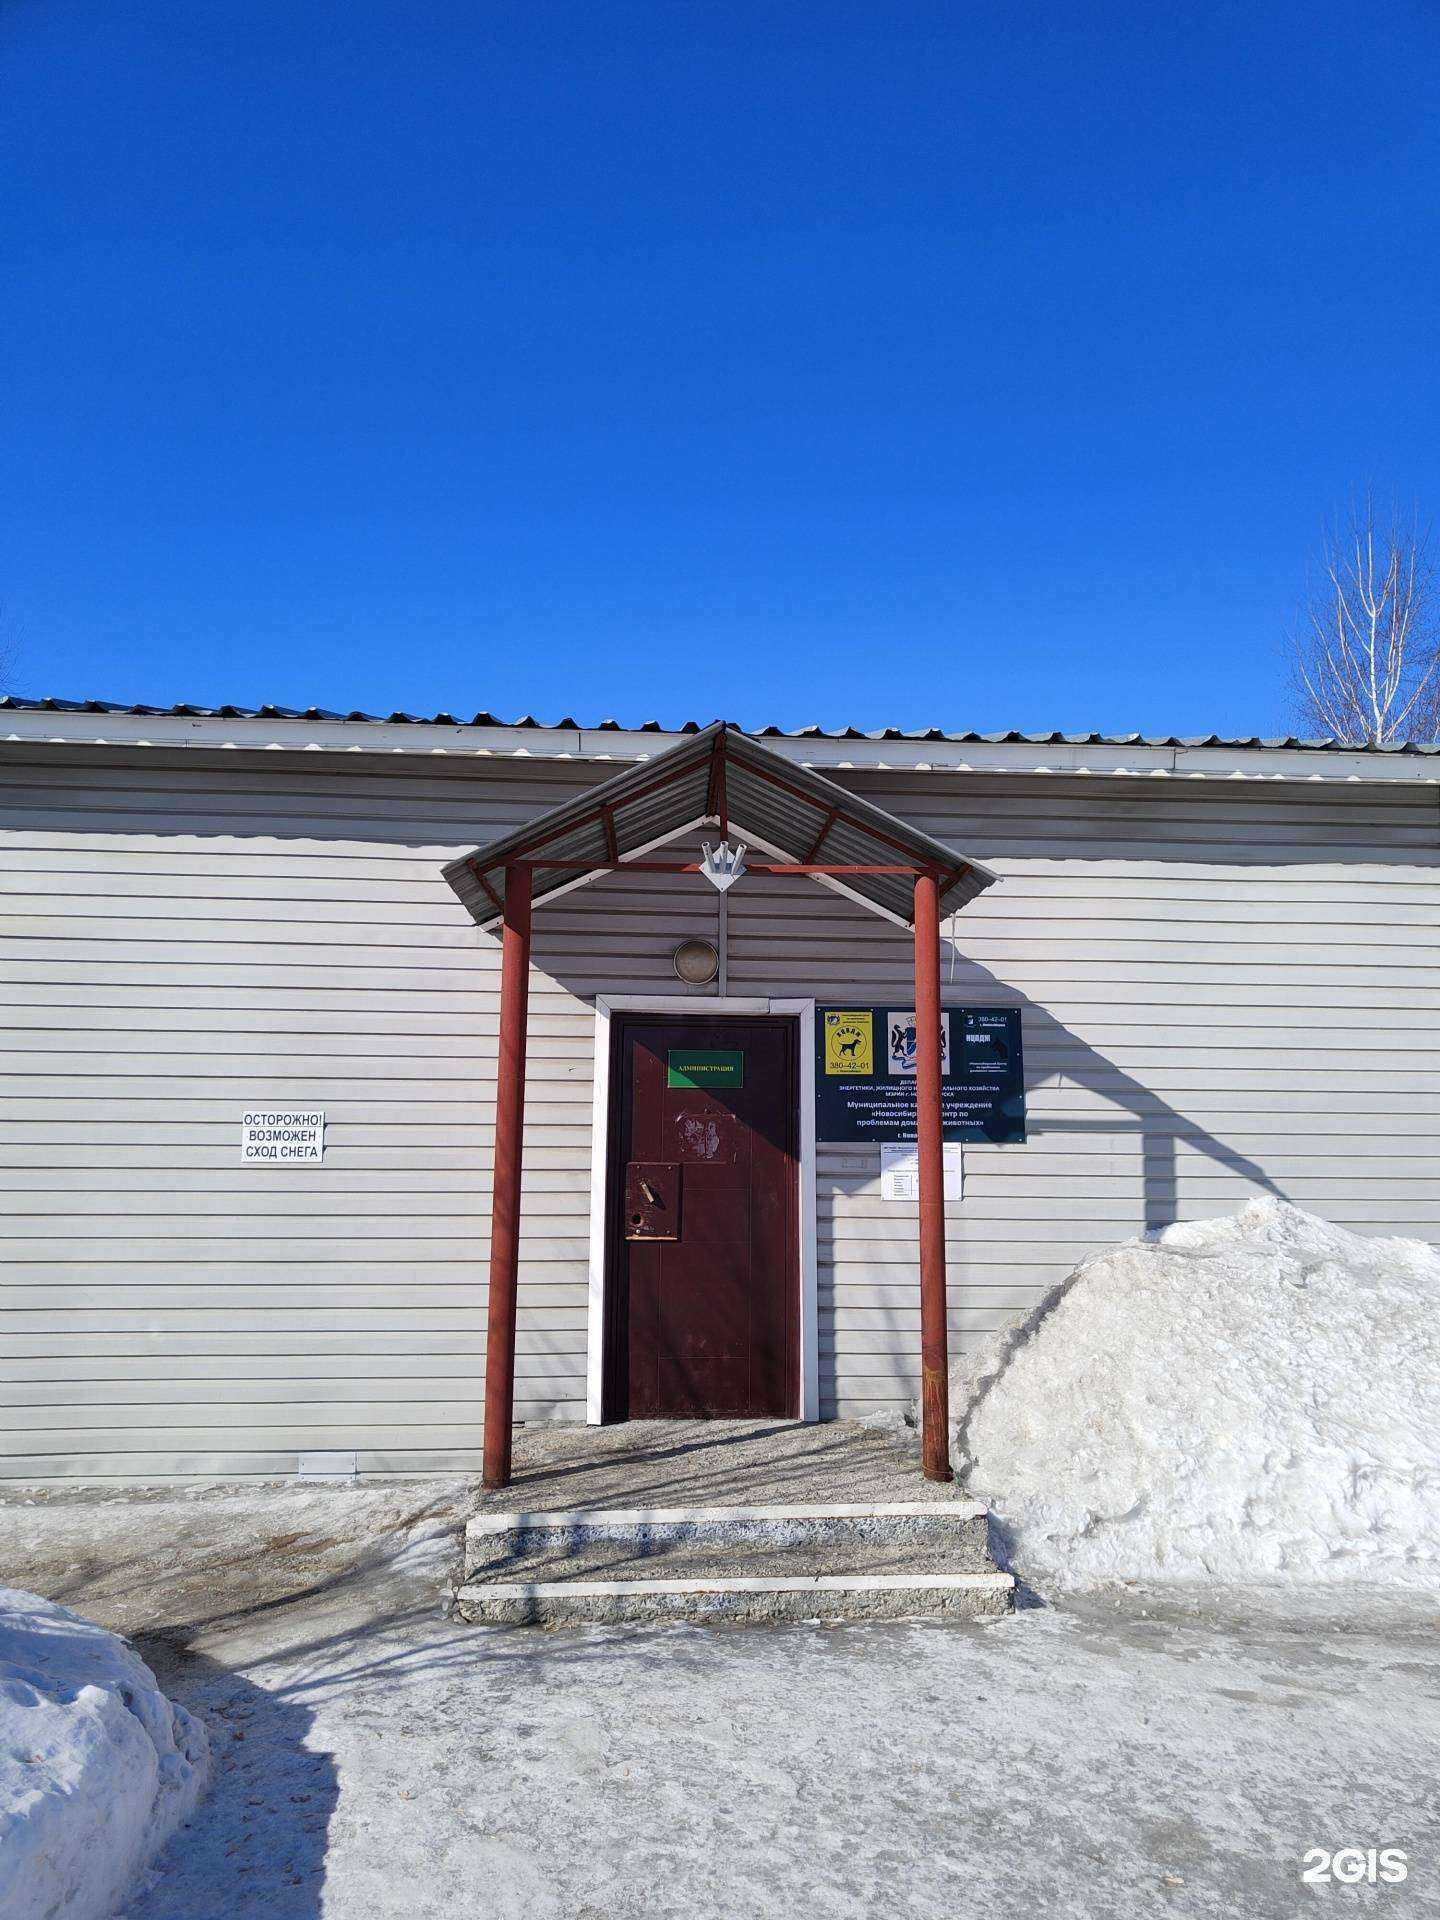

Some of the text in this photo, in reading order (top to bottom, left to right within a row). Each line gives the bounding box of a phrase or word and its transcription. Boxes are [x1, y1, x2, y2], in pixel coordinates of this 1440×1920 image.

[847, 1101, 909, 1109] Муниципальное
[946, 1102, 993, 1110] учреждение
[244, 1114, 322, 1126] ОСТОРОЖНО!
[871, 1110, 917, 1118] «Новосибир
[249, 1130, 316, 1142] ВОЗМОЖЕН
[246, 1146, 318, 1159] СХОД СНЕГА
